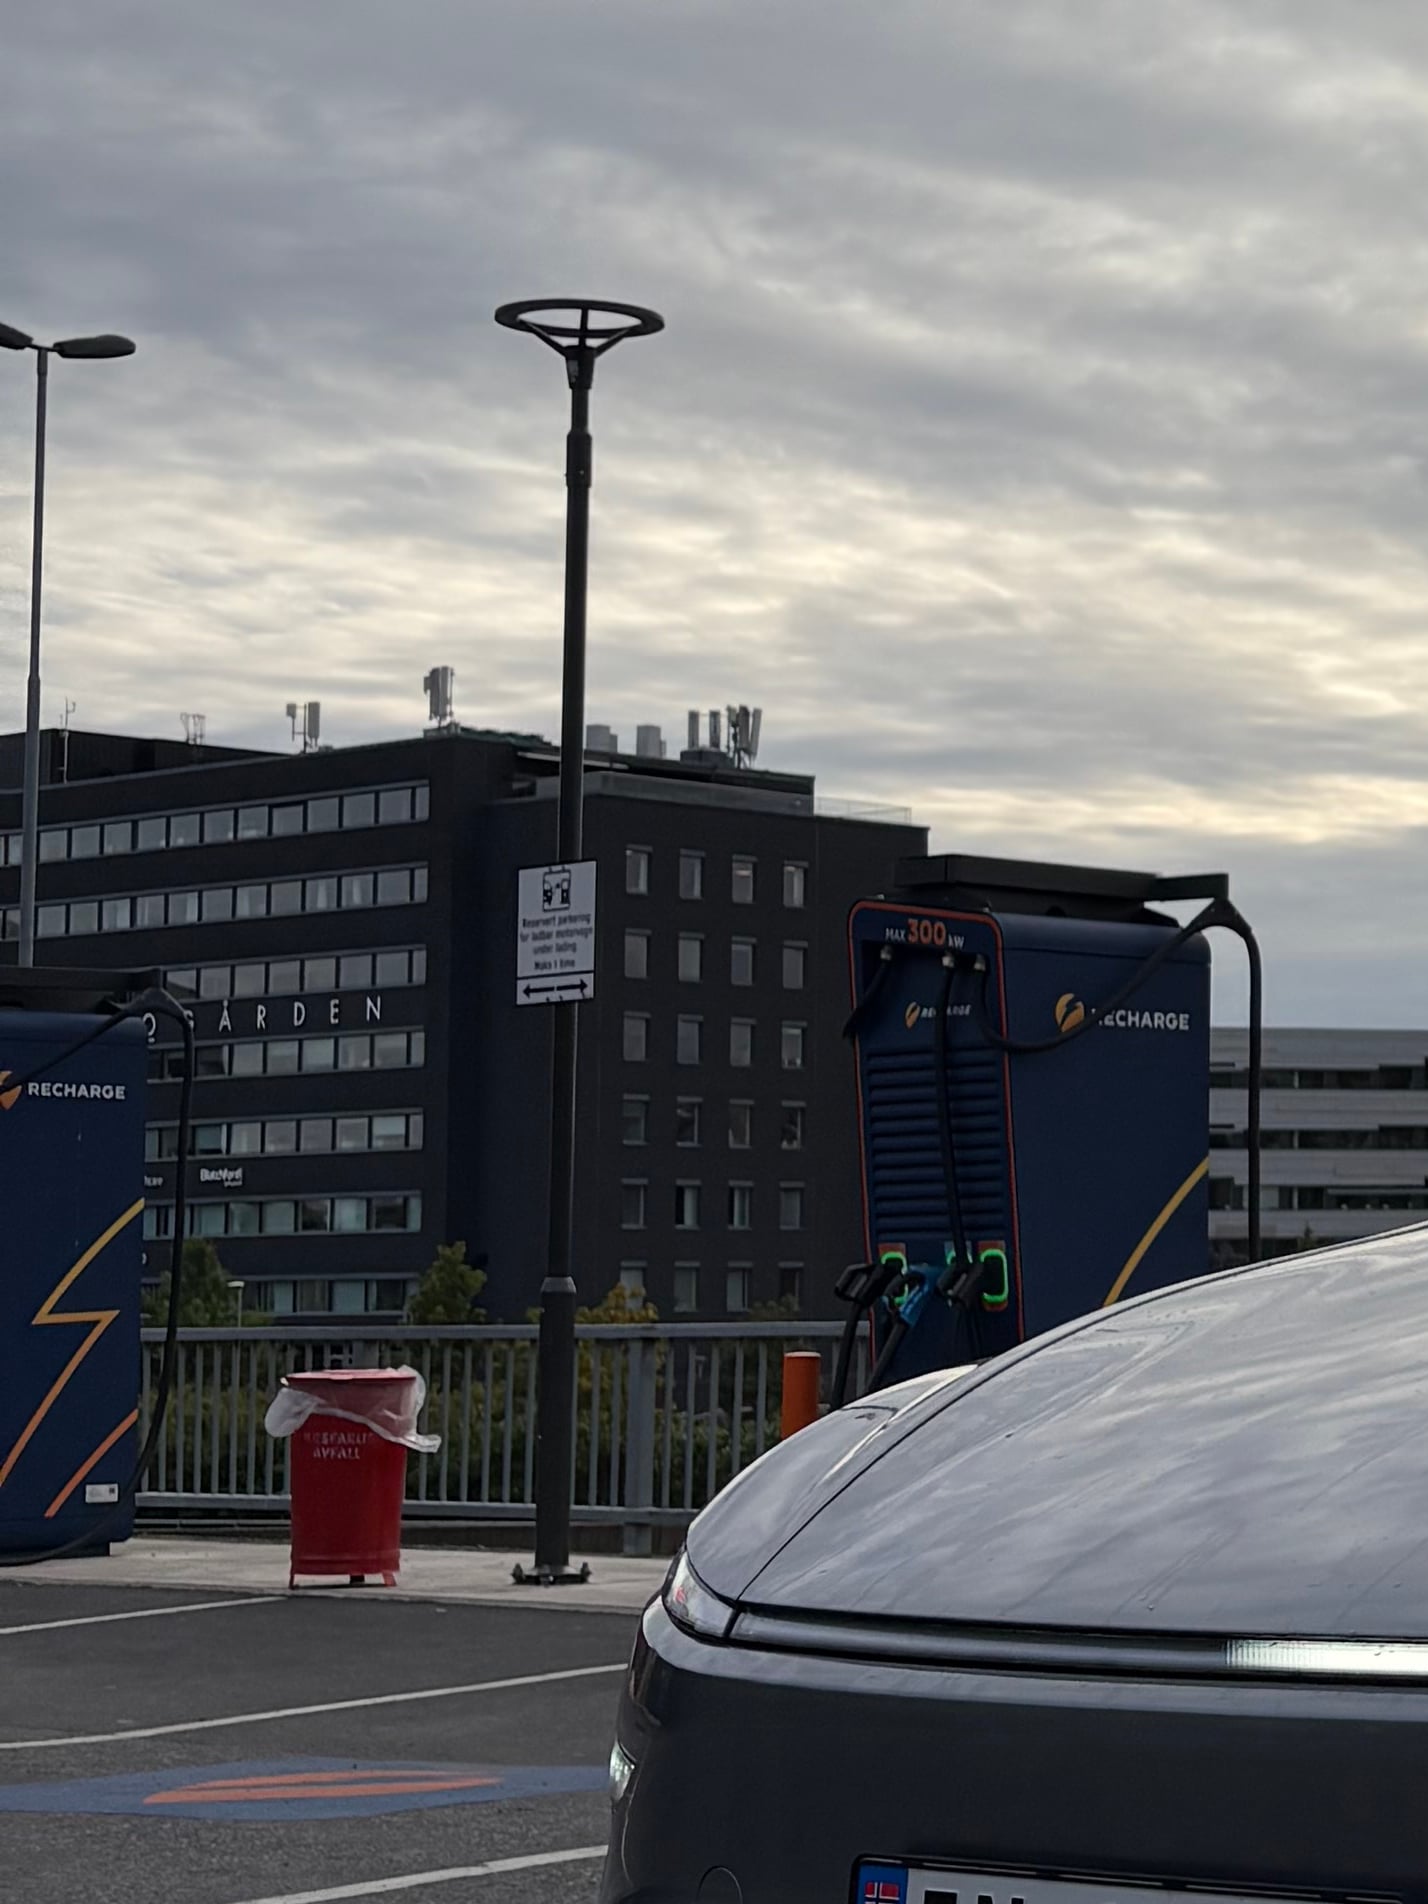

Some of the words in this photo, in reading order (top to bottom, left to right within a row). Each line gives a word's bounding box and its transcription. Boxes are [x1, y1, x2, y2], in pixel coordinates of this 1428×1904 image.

[885, 927, 906, 942] MAX
[907, 918, 947, 946] 300
[1091, 1007, 1190, 1031] ECHARGE
[27, 1082, 126, 1100] RECHARGE
[313, 1447, 360, 1459] AVFALL
